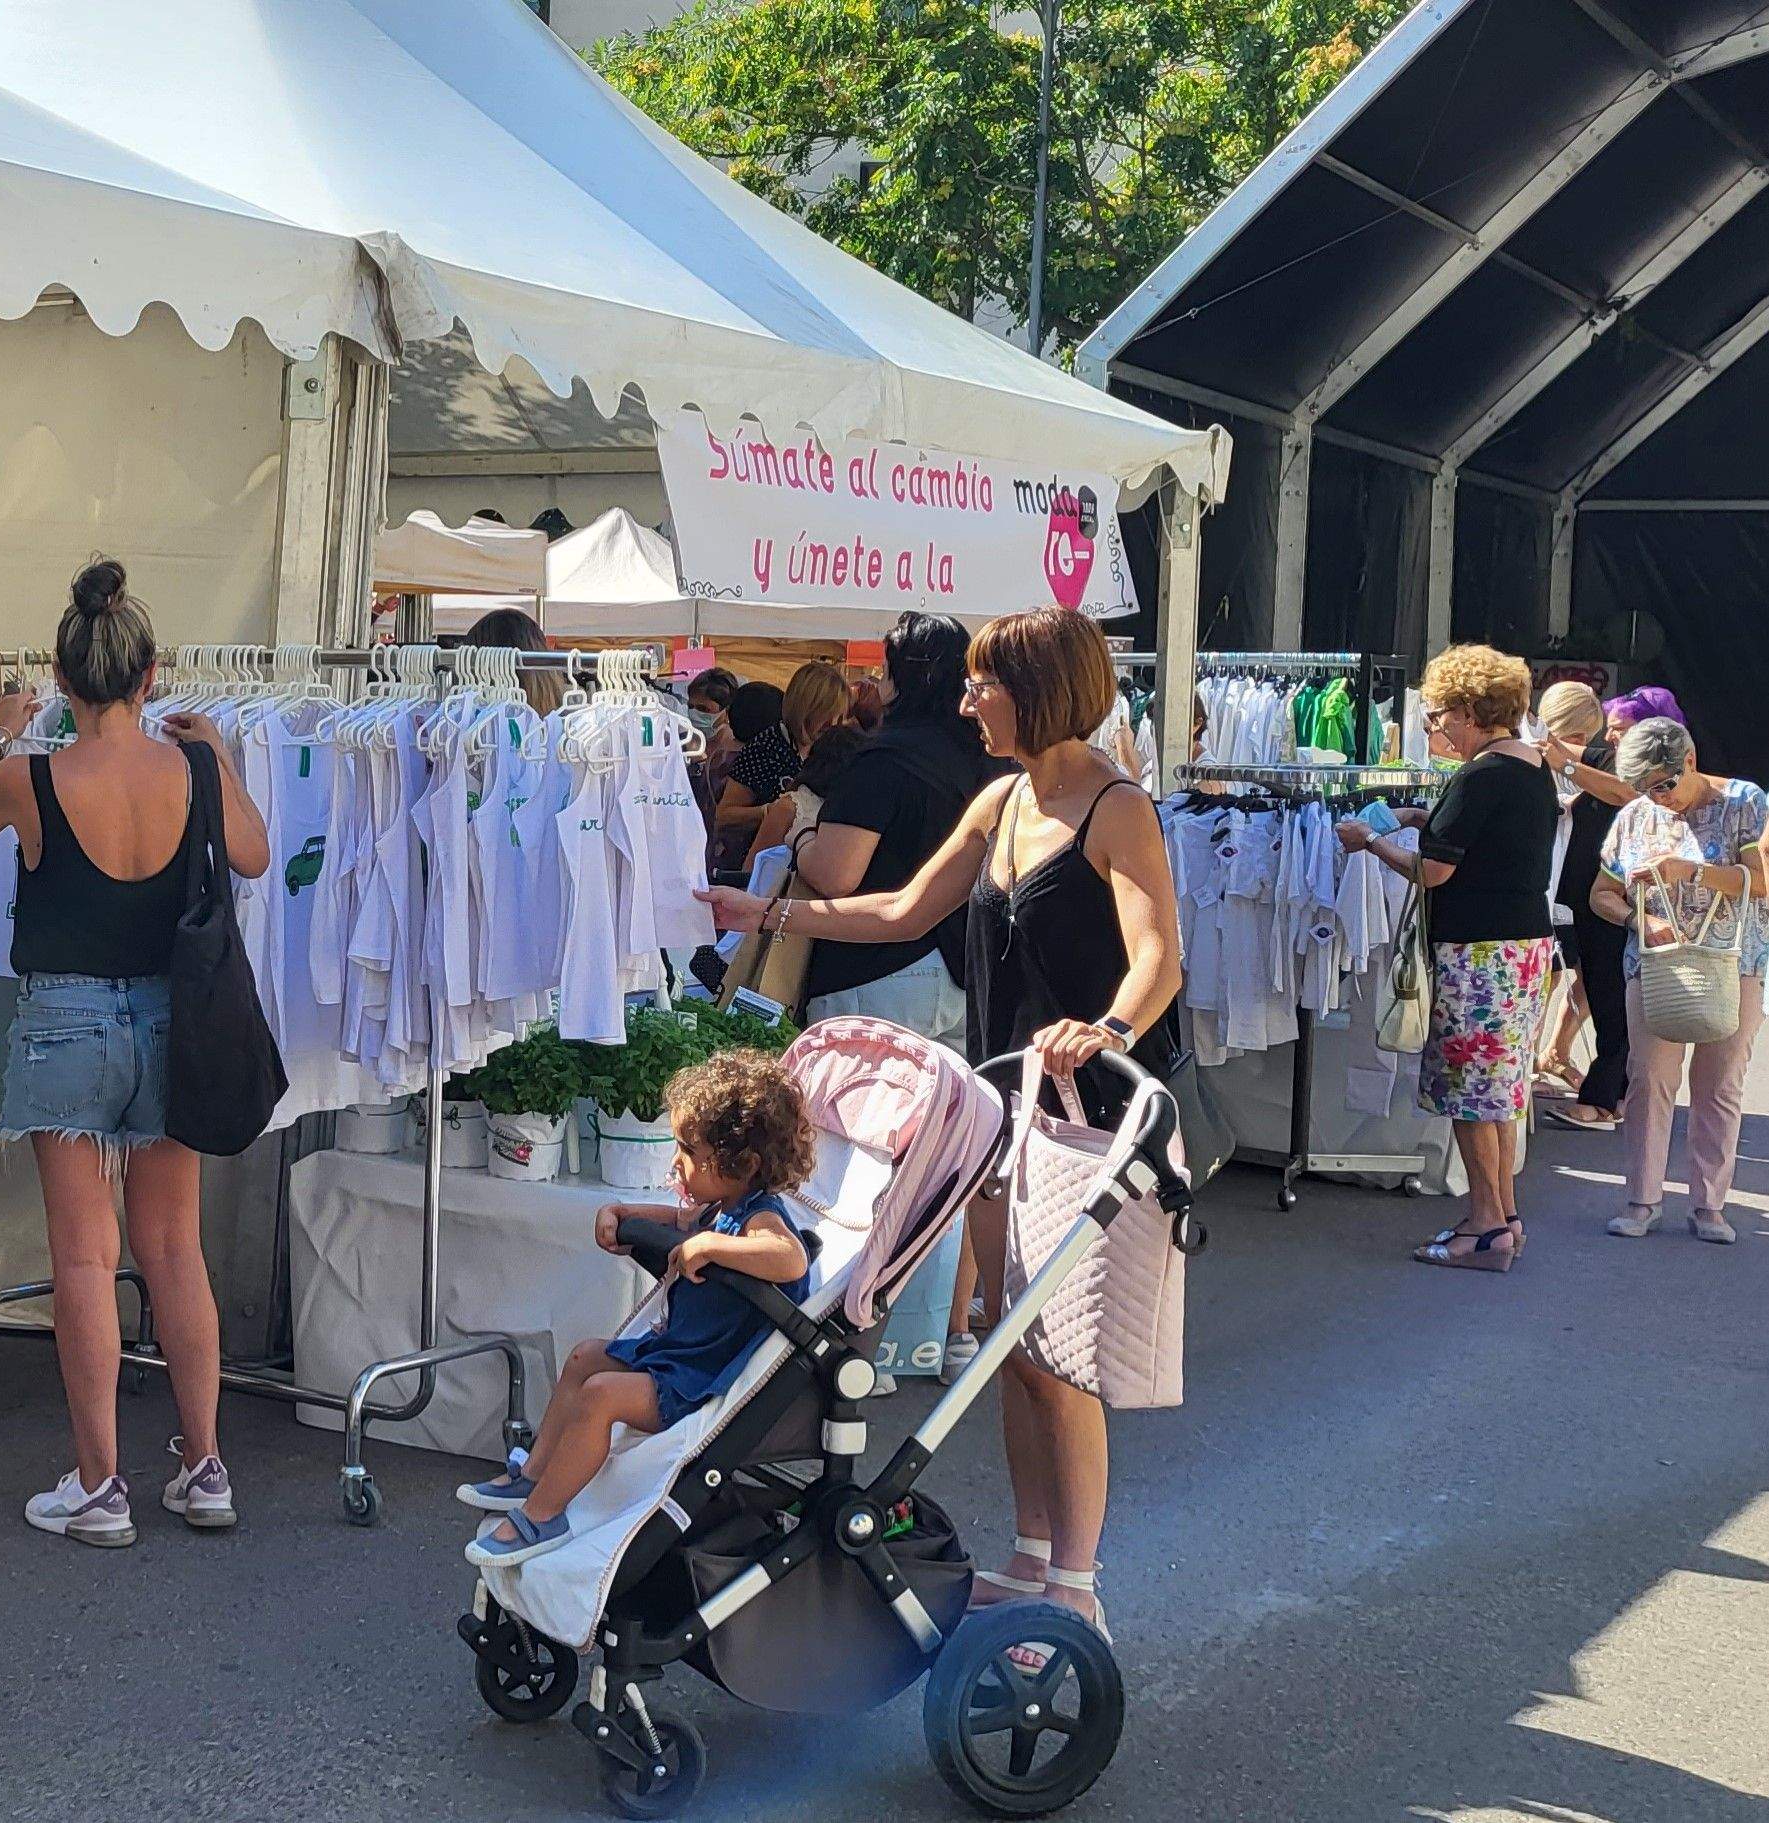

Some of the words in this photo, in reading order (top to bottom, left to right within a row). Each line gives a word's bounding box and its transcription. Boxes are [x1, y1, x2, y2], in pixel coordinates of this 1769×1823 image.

[709, 427, 835, 494] Súmate
[848, 448, 880, 500] al
[891, 459, 993, 512] cambio
[1013, 473, 1078, 518] moda
[754, 537, 773, 594] y
[788, 530, 882, 589] únete
[896, 551, 913, 592] a
[927, 541, 954, 594] la
